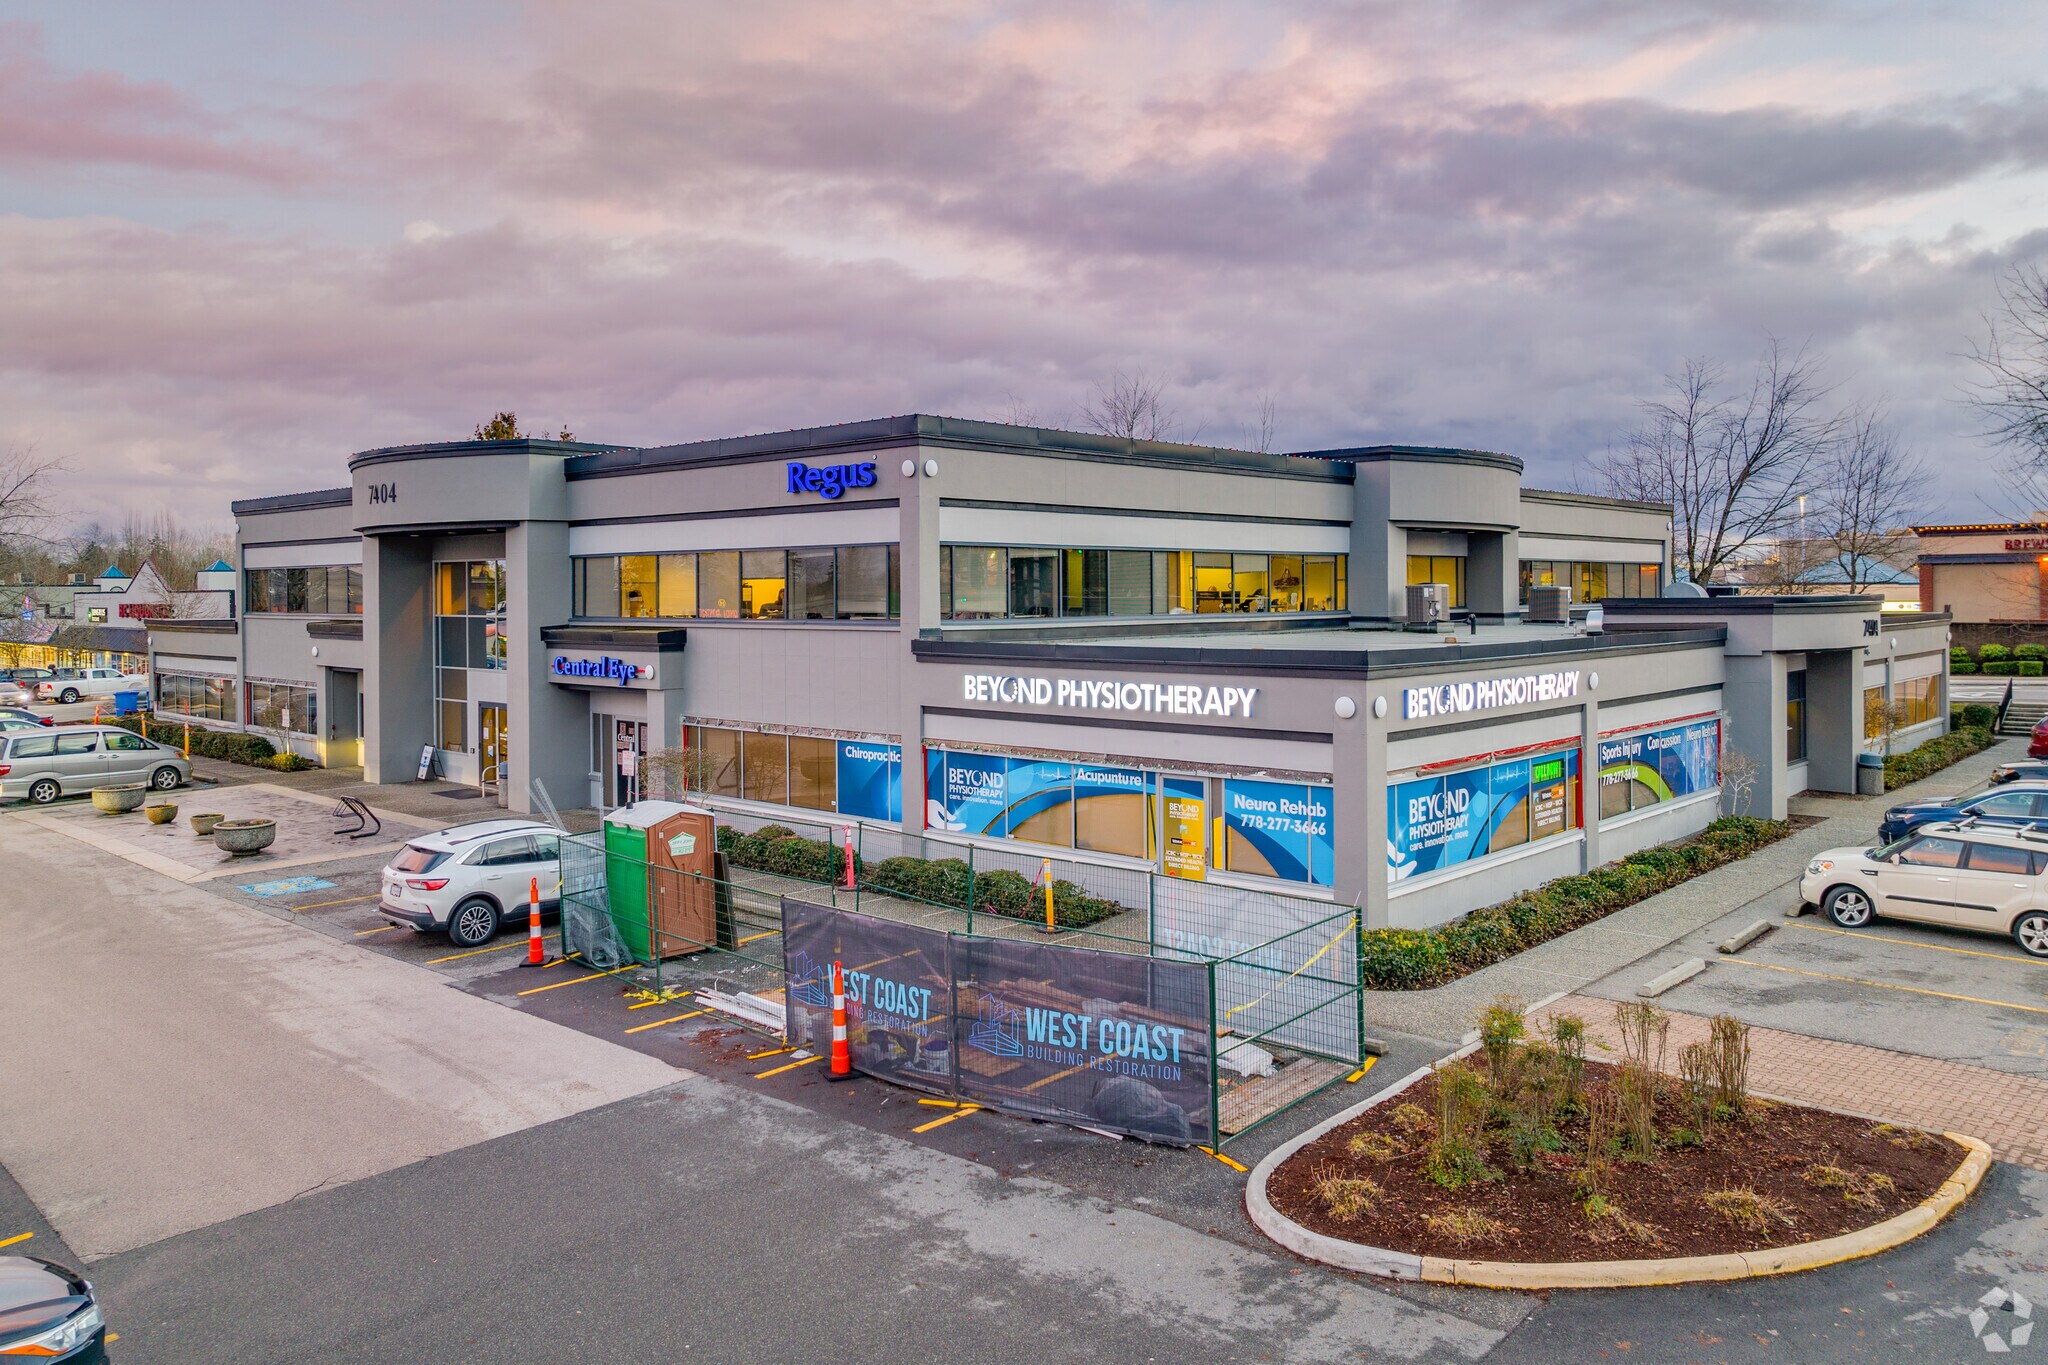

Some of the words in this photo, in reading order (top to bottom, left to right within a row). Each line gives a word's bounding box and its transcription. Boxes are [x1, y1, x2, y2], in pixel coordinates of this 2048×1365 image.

[786, 461, 877, 499] Regus
[368, 482, 397, 504] 7404
[2004, 539, 2048, 550] BREW
[554, 656, 608, 678] Central
[608, 658, 638, 687] Eye
[964, 675, 1052, 705] BEYOND
[1058, 679, 1259, 717] PHYSIOTHERAPY
[1405, 684, 1475, 720] BEYOND
[1477, 671, 1580, 711] PHYSIOTHERAPY
[1602, 744, 1622, 763] Sports
[1622, 740, 1642, 758] Injury
[1647, 732, 1681, 751] Concussion
[845, 746, 901, 763] Chiropractic
[949, 768, 1004, 789] BEYOND
[1077, 768, 1142, 786] Acupunture
[949, 784, 1004, 798] PHYSIOTHERAPY
[1169, 802, 1199, 813] BEYOND
[1234, 794, 1277, 812] Neuro
[1280, 798, 1327, 818] Rehab
[1409, 788, 1470, 825] BEYOND
[1240, 814, 1327, 836] 778-277-3666
[1409, 813, 1470, 841] PHYSIOTHERAPY
[874, 977, 932, 1021] COAST
[867, 1009, 928, 1037] RESTORATION
[1025, 1007, 1092, 1050] WEST
[1100, 1018, 1184, 1063] COAST
[1027, 1045, 1084, 1067] BUILDING
[1089, 1055, 1181, 1081] RESTORATION
